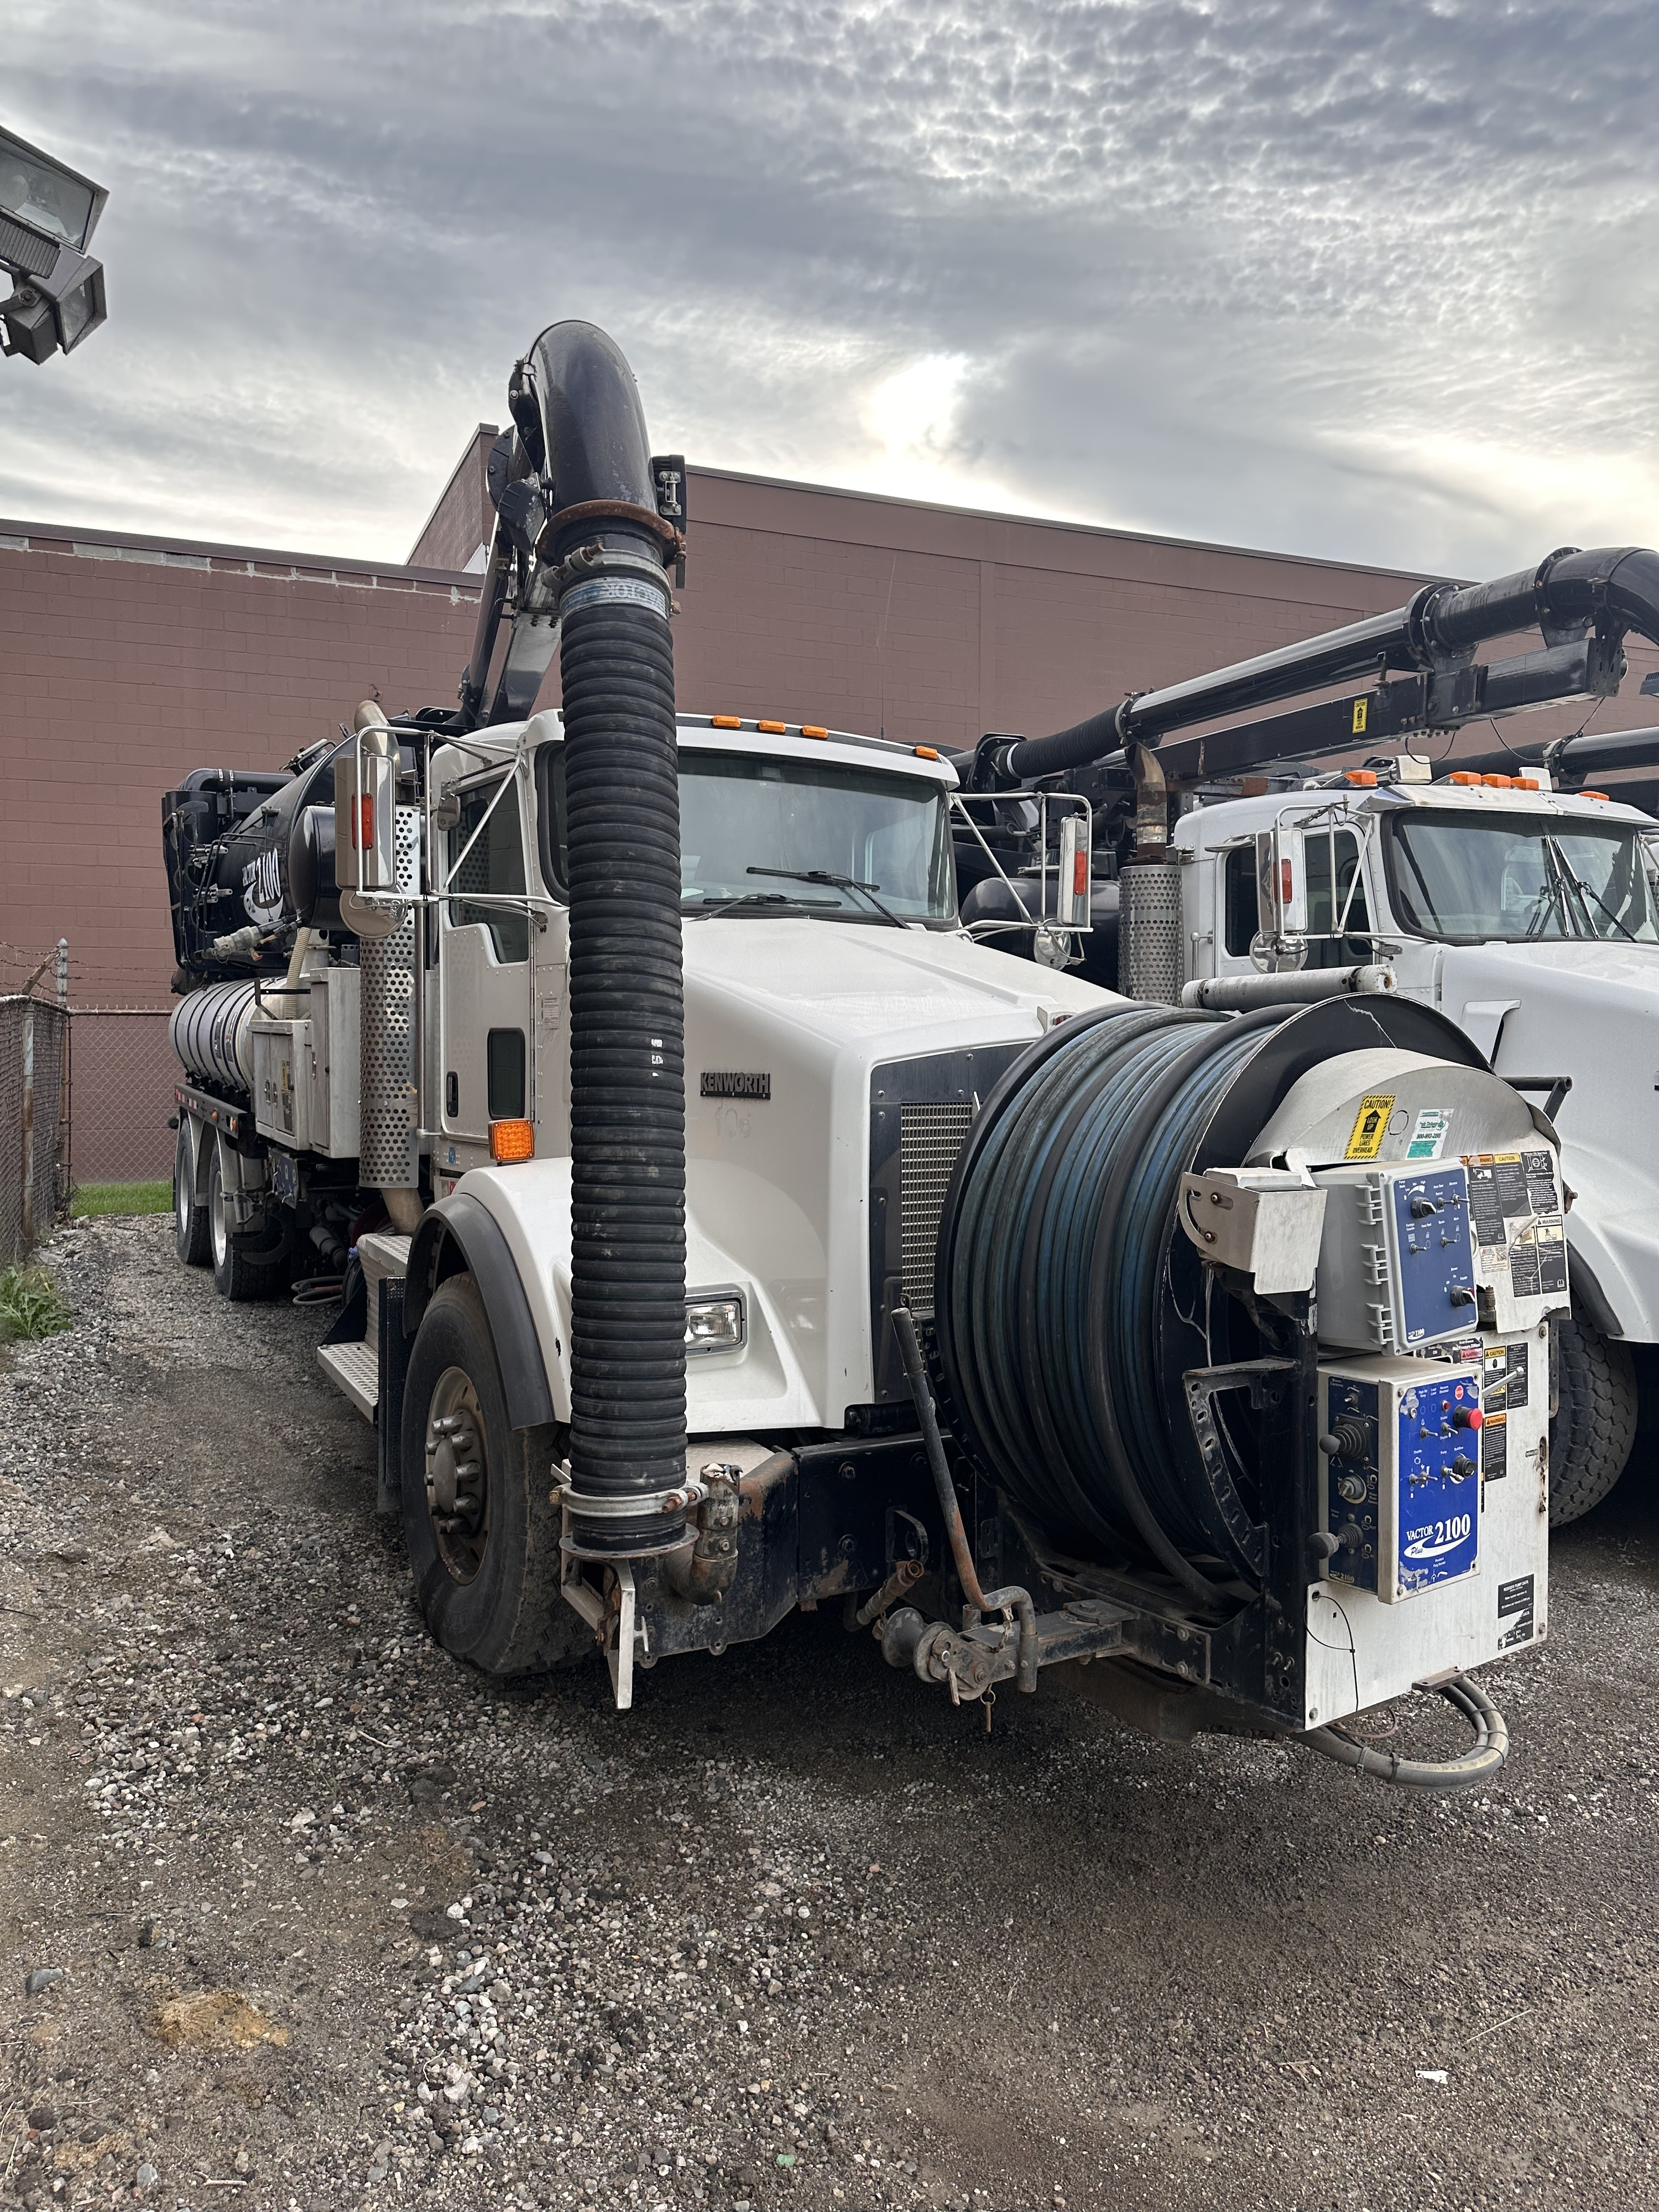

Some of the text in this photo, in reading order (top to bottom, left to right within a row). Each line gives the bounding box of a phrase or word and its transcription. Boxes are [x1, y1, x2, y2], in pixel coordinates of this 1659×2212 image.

[256, 847, 281, 904] 2100
[701, 1072, 770, 1093] KENWORTH
[1364, 1099, 1391, 1109] CAUTION!
[1406, 1514, 1471, 1545] VACTOR 2100
[1411, 1547, 1423, 1556] Plus
[1340, 1573, 1355, 1582] 2100
